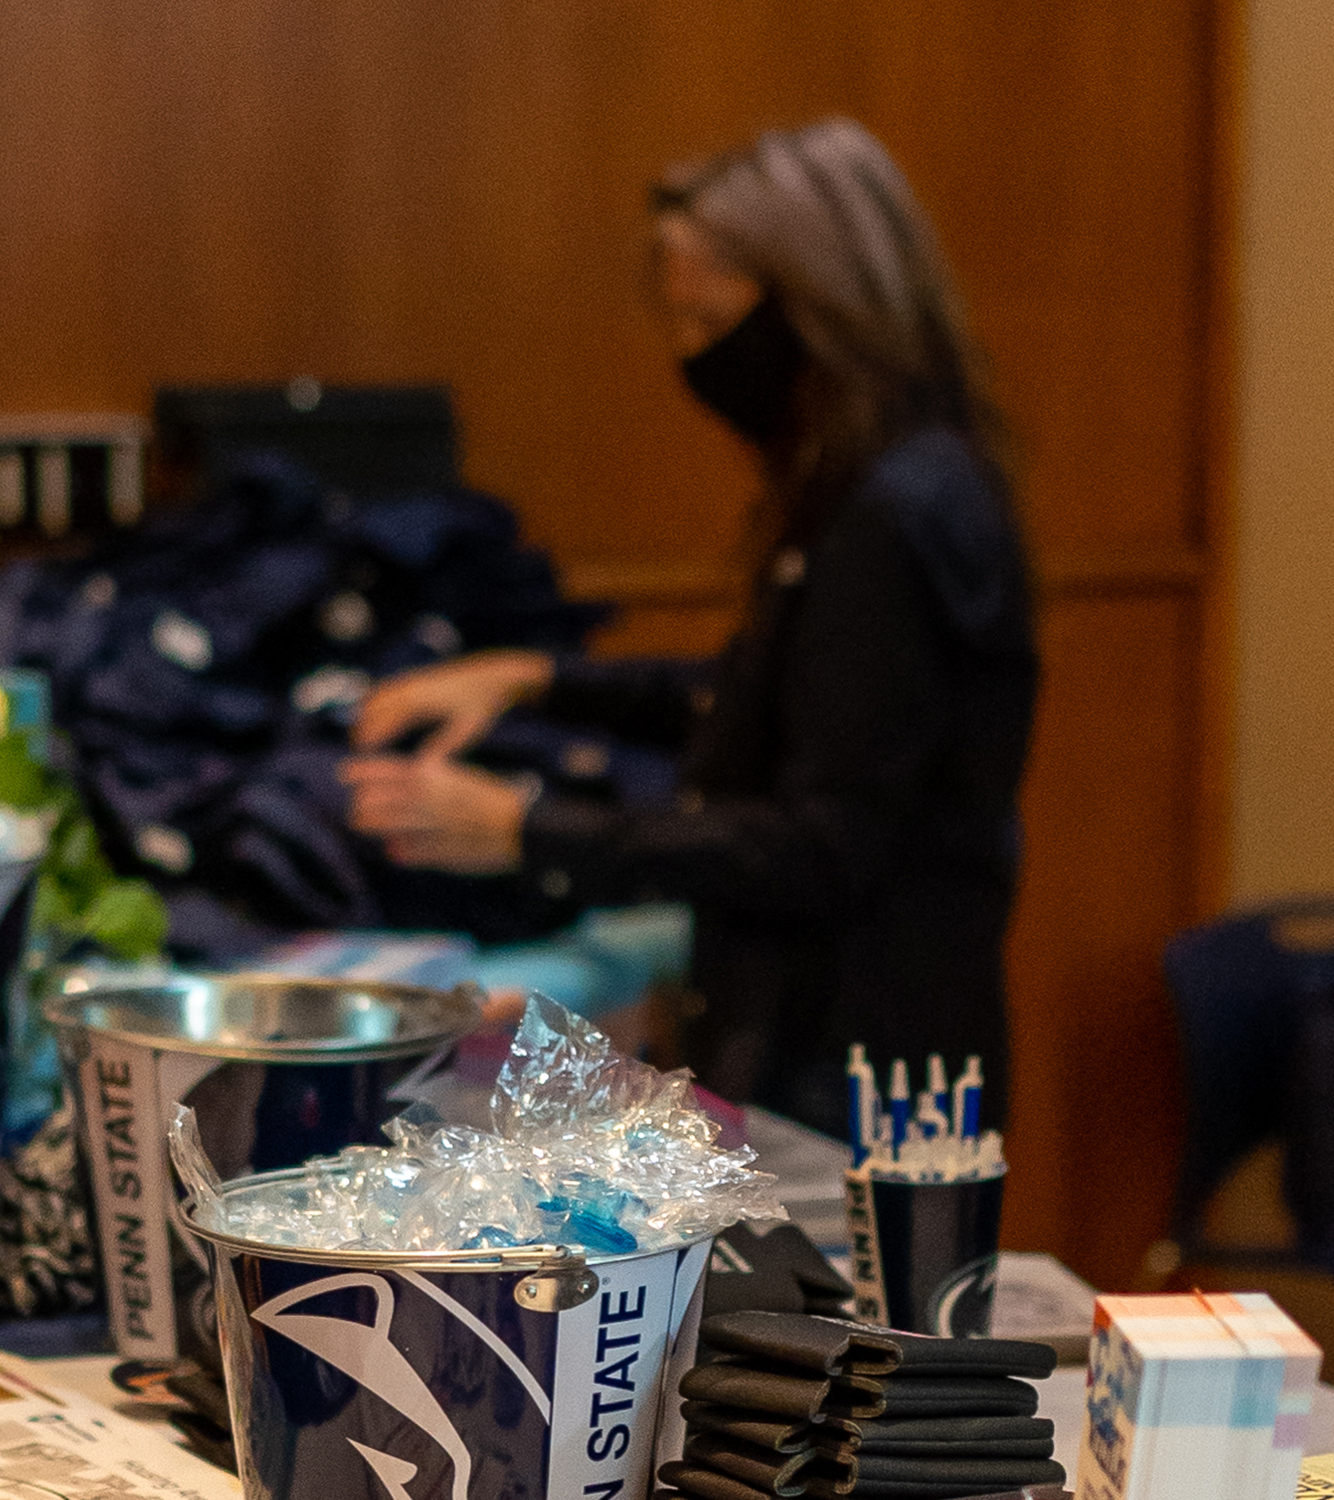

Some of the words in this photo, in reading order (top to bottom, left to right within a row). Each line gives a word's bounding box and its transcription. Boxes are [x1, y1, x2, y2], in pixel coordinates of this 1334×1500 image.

[94, 1057, 144, 1201] STATE
[115, 1212, 154, 1341] PENN
[586, 1285, 648, 1463] STATE
